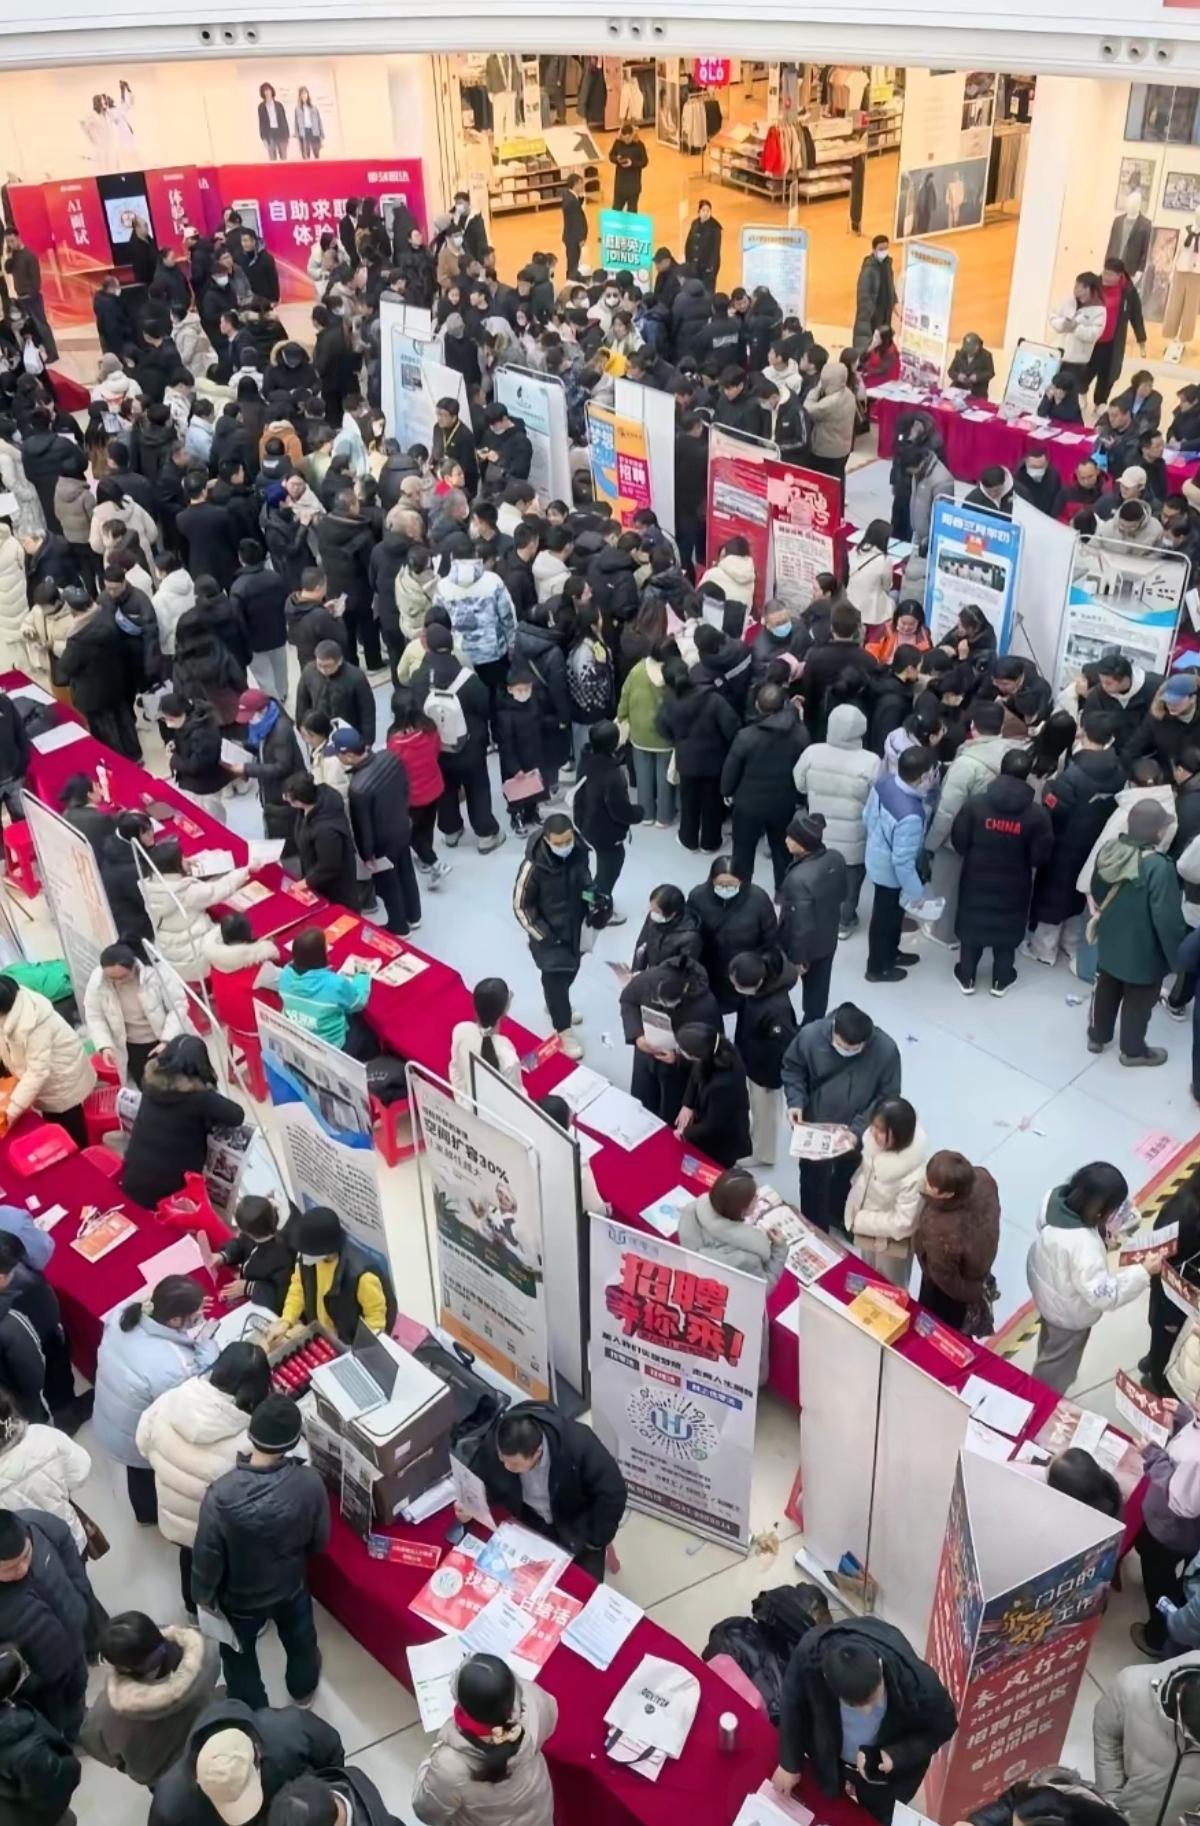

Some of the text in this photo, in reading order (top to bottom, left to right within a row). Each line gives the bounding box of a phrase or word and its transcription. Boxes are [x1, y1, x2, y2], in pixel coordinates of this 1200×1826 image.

[985, 817, 1021, 835] CHINA
[620, 1252, 729, 1322] 招聘
[970, 1640, 1087, 1712] 春风行动
